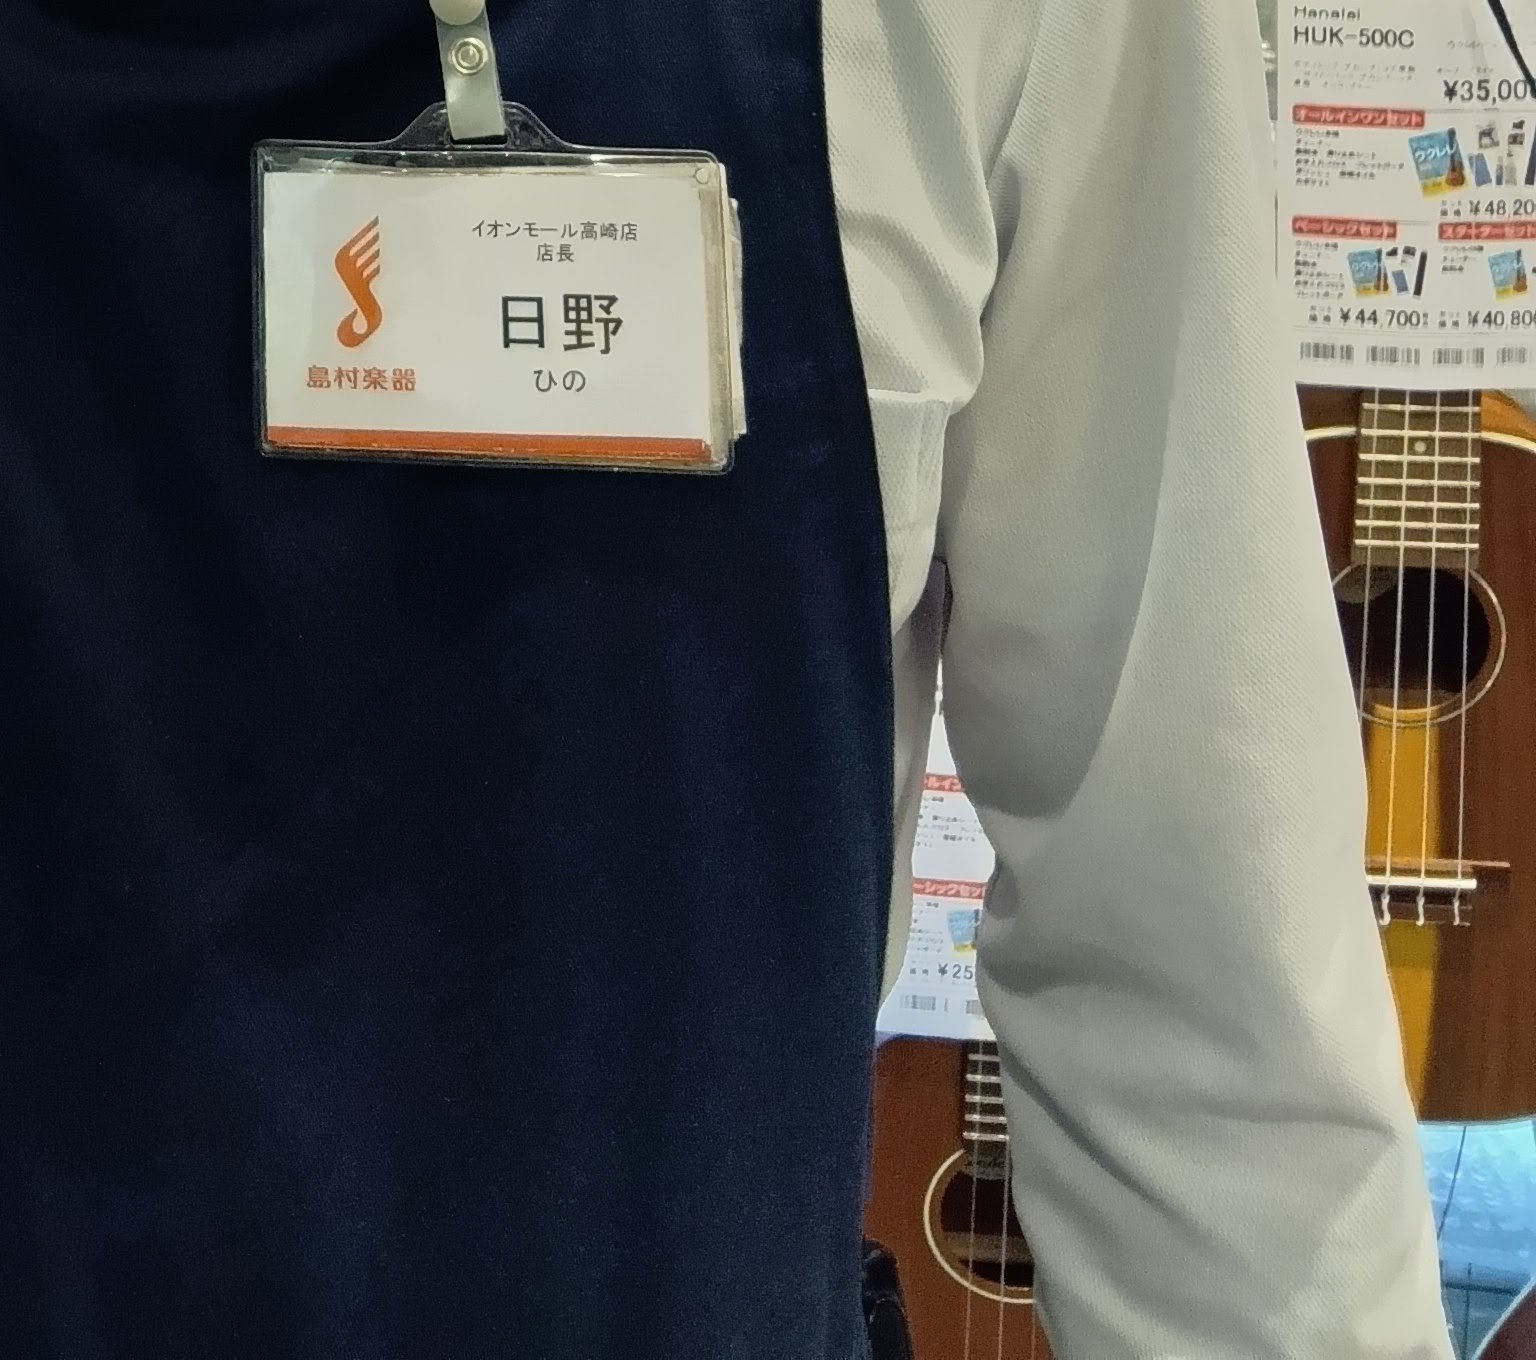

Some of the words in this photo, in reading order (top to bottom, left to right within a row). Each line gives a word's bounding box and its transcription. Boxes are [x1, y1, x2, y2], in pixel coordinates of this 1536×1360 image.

[1294, 5, 1361, 20] Hanalei
[1294, 26, 1414, 48] HUK-500C
[1443, 79, 1536, 104] ¥35,00
[1469, 199, 1536, 218] ¥48,20
[472, 219, 638, 242] イオンモール高崎店
[536, 243, 574, 263] 店長
[501, 292, 623, 355] 日野
[1339, 307, 1421, 328] ¥44,700
[1467, 310, 1536, 329] ¥40,80
[306, 365, 416, 391] 島村楽器
[533, 369, 586, 393] ひの
